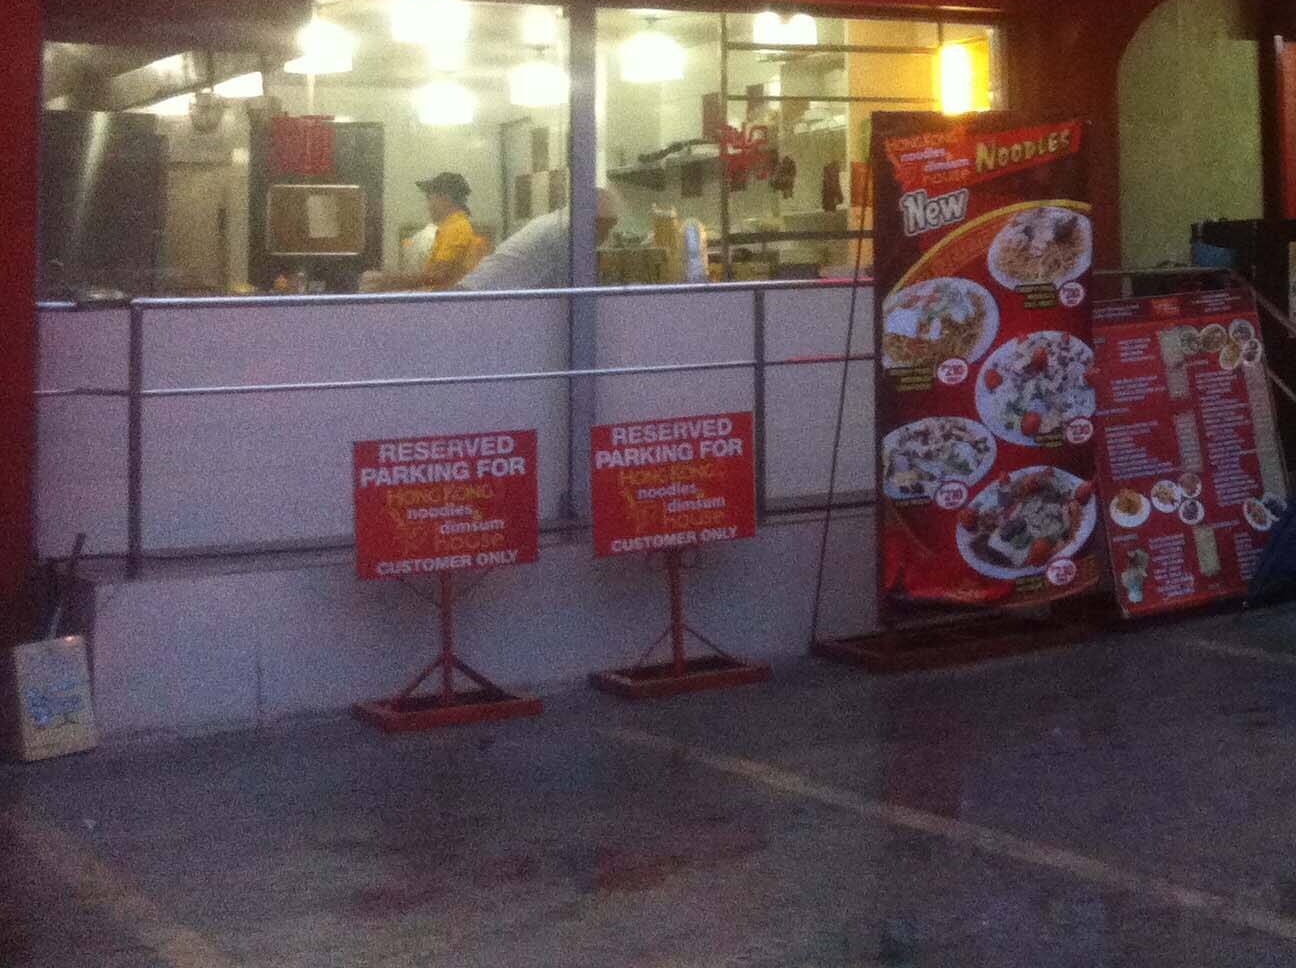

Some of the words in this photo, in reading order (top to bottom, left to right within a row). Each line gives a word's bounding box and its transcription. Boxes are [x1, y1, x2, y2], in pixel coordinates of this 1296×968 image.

[901, 188, 969, 236] New
[612, 418, 733, 447] RESERVED
[378, 435, 515, 464] RESERVED
[595, 443, 693, 469] PARKING
[700, 438, 744, 459] FOR
[360, 461, 470, 488] PARKING
[476, 457, 526, 478] FOR
[611, 531, 696, 553] CUSTOMER
[701, 526, 737, 543] ONLY
[376, 554, 473, 575] CUSTOMER
[475, 549, 519, 565] ONLY
